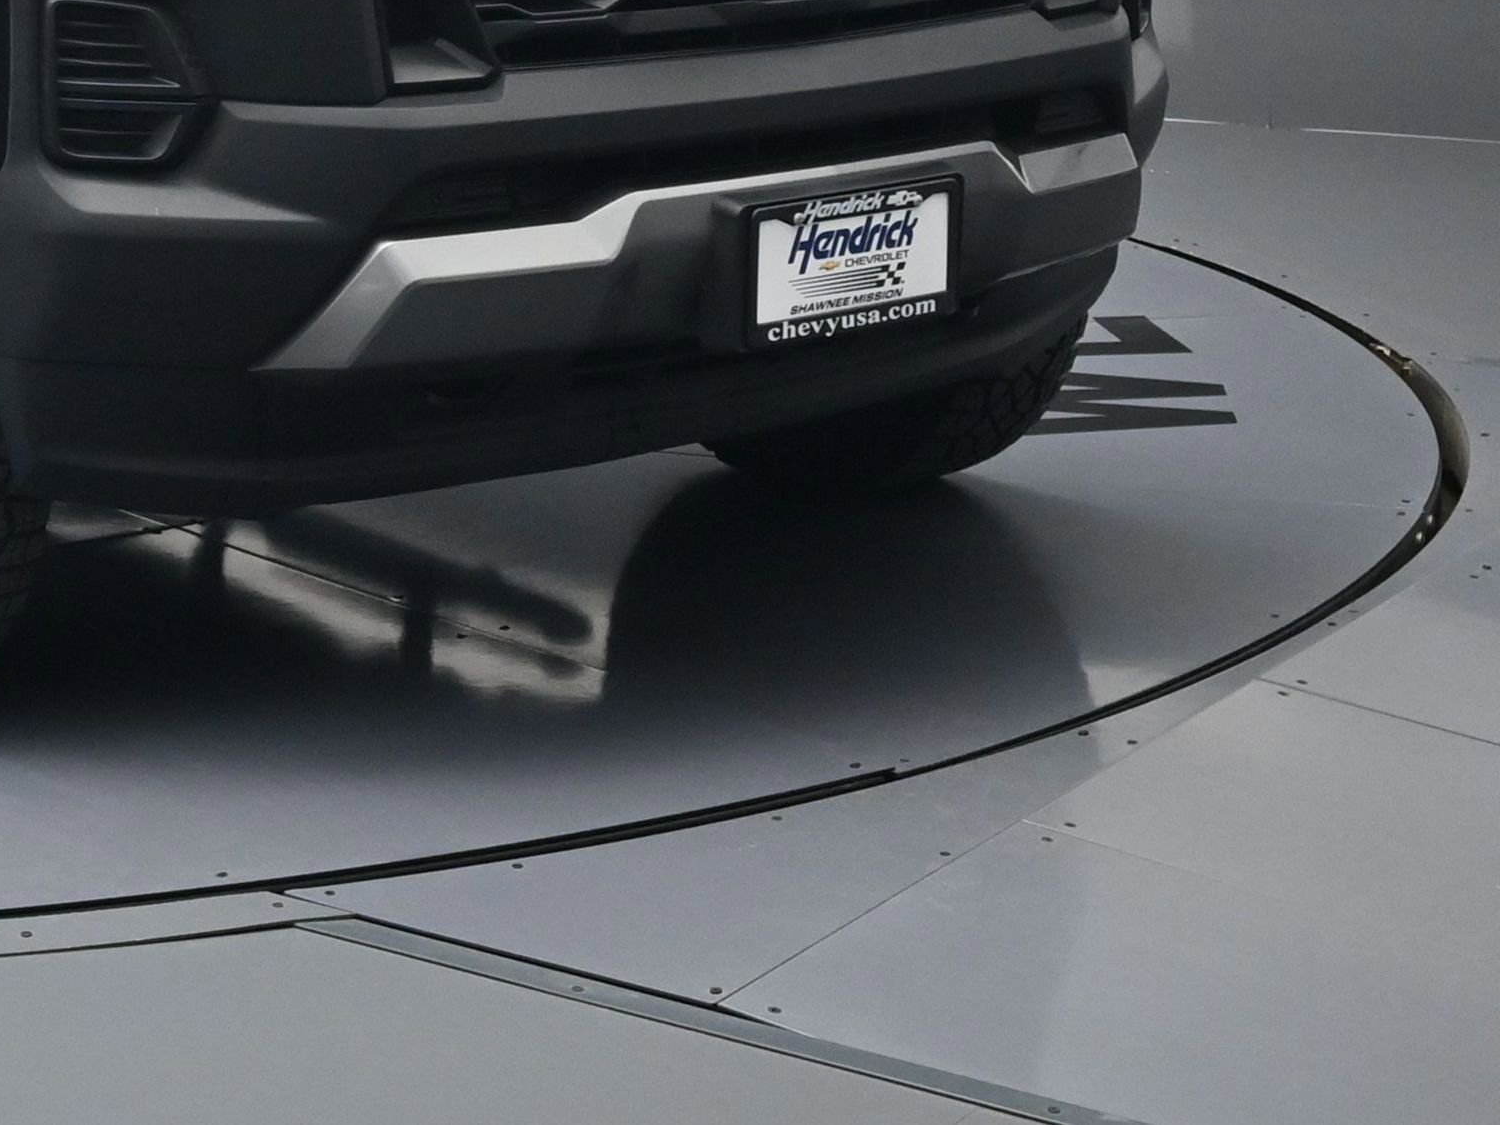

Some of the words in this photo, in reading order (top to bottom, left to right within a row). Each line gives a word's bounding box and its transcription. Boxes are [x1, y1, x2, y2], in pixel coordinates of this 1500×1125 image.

[802, 192, 884, 223] Hendrick
[788, 210, 919, 275] Hendrick
[844, 249, 910, 268] CHEVROLET
[790, 296, 850, 316] SHAWNEE
[852, 288, 904, 305] MISSION
[767, 298, 937, 343] chevyusa.com
